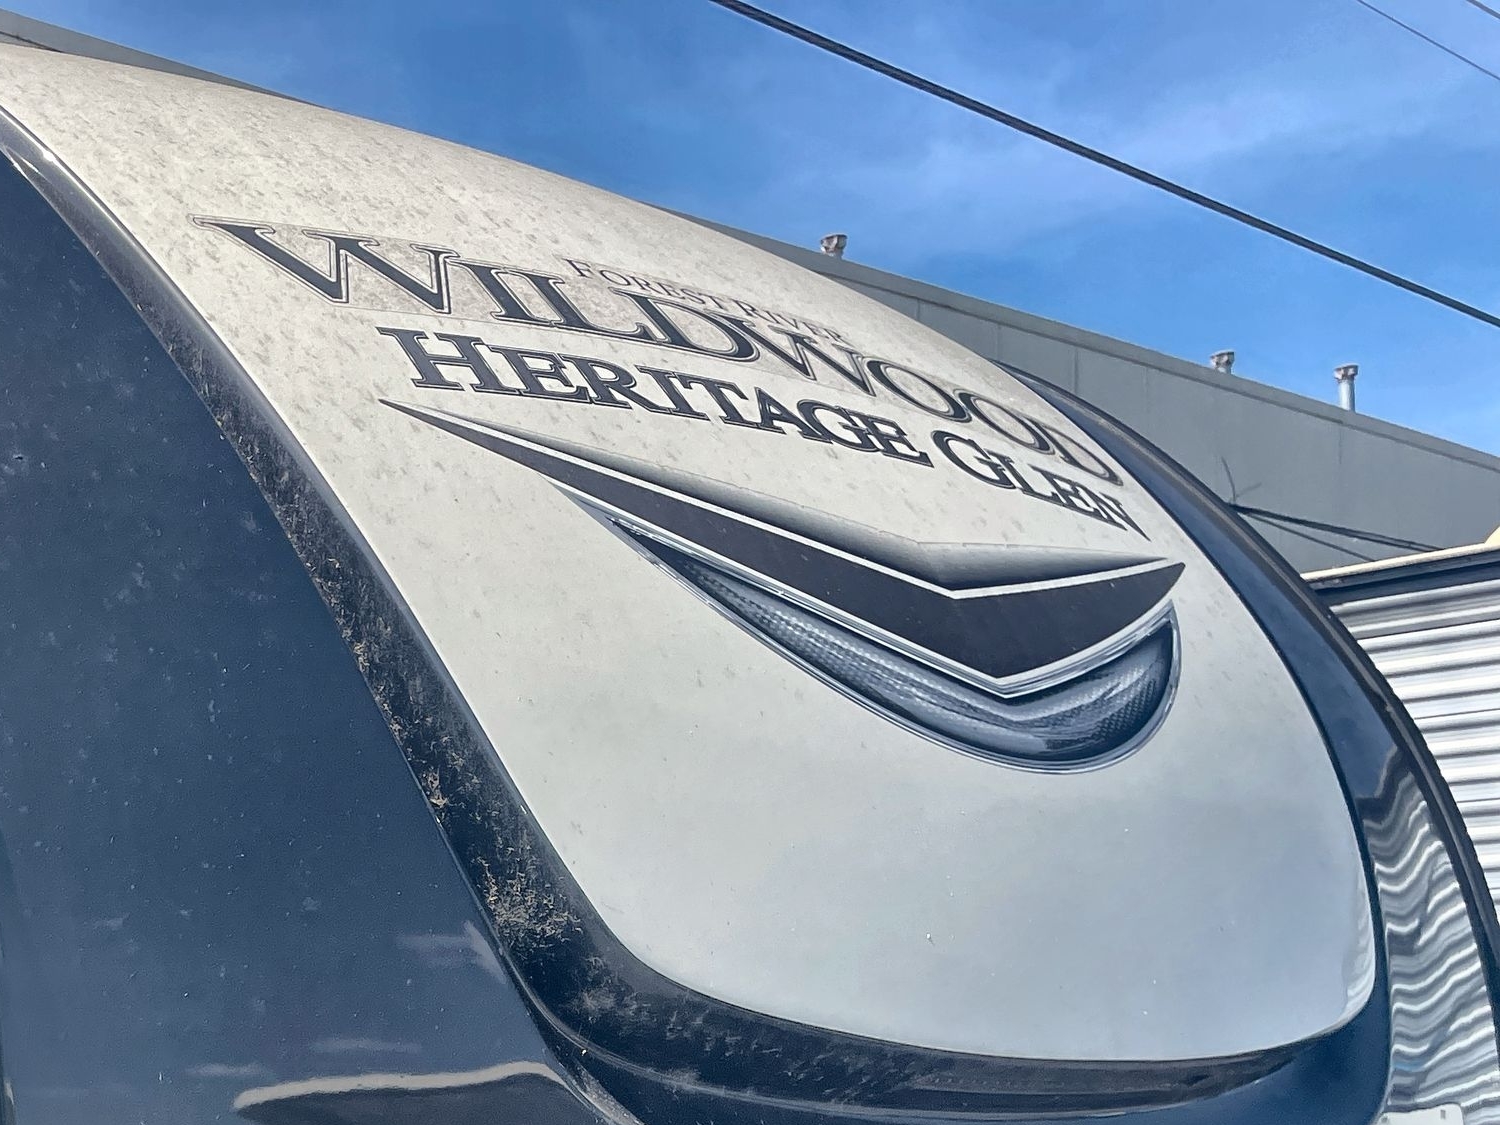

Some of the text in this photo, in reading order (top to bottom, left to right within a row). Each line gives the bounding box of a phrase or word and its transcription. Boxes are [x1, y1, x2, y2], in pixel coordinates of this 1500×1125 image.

[188, 215, 1124, 486] WILDWOOD
[563, 257, 856, 349] FOREST RIVER
[377, 326, 1151, 542] HERITAGE GLEN
